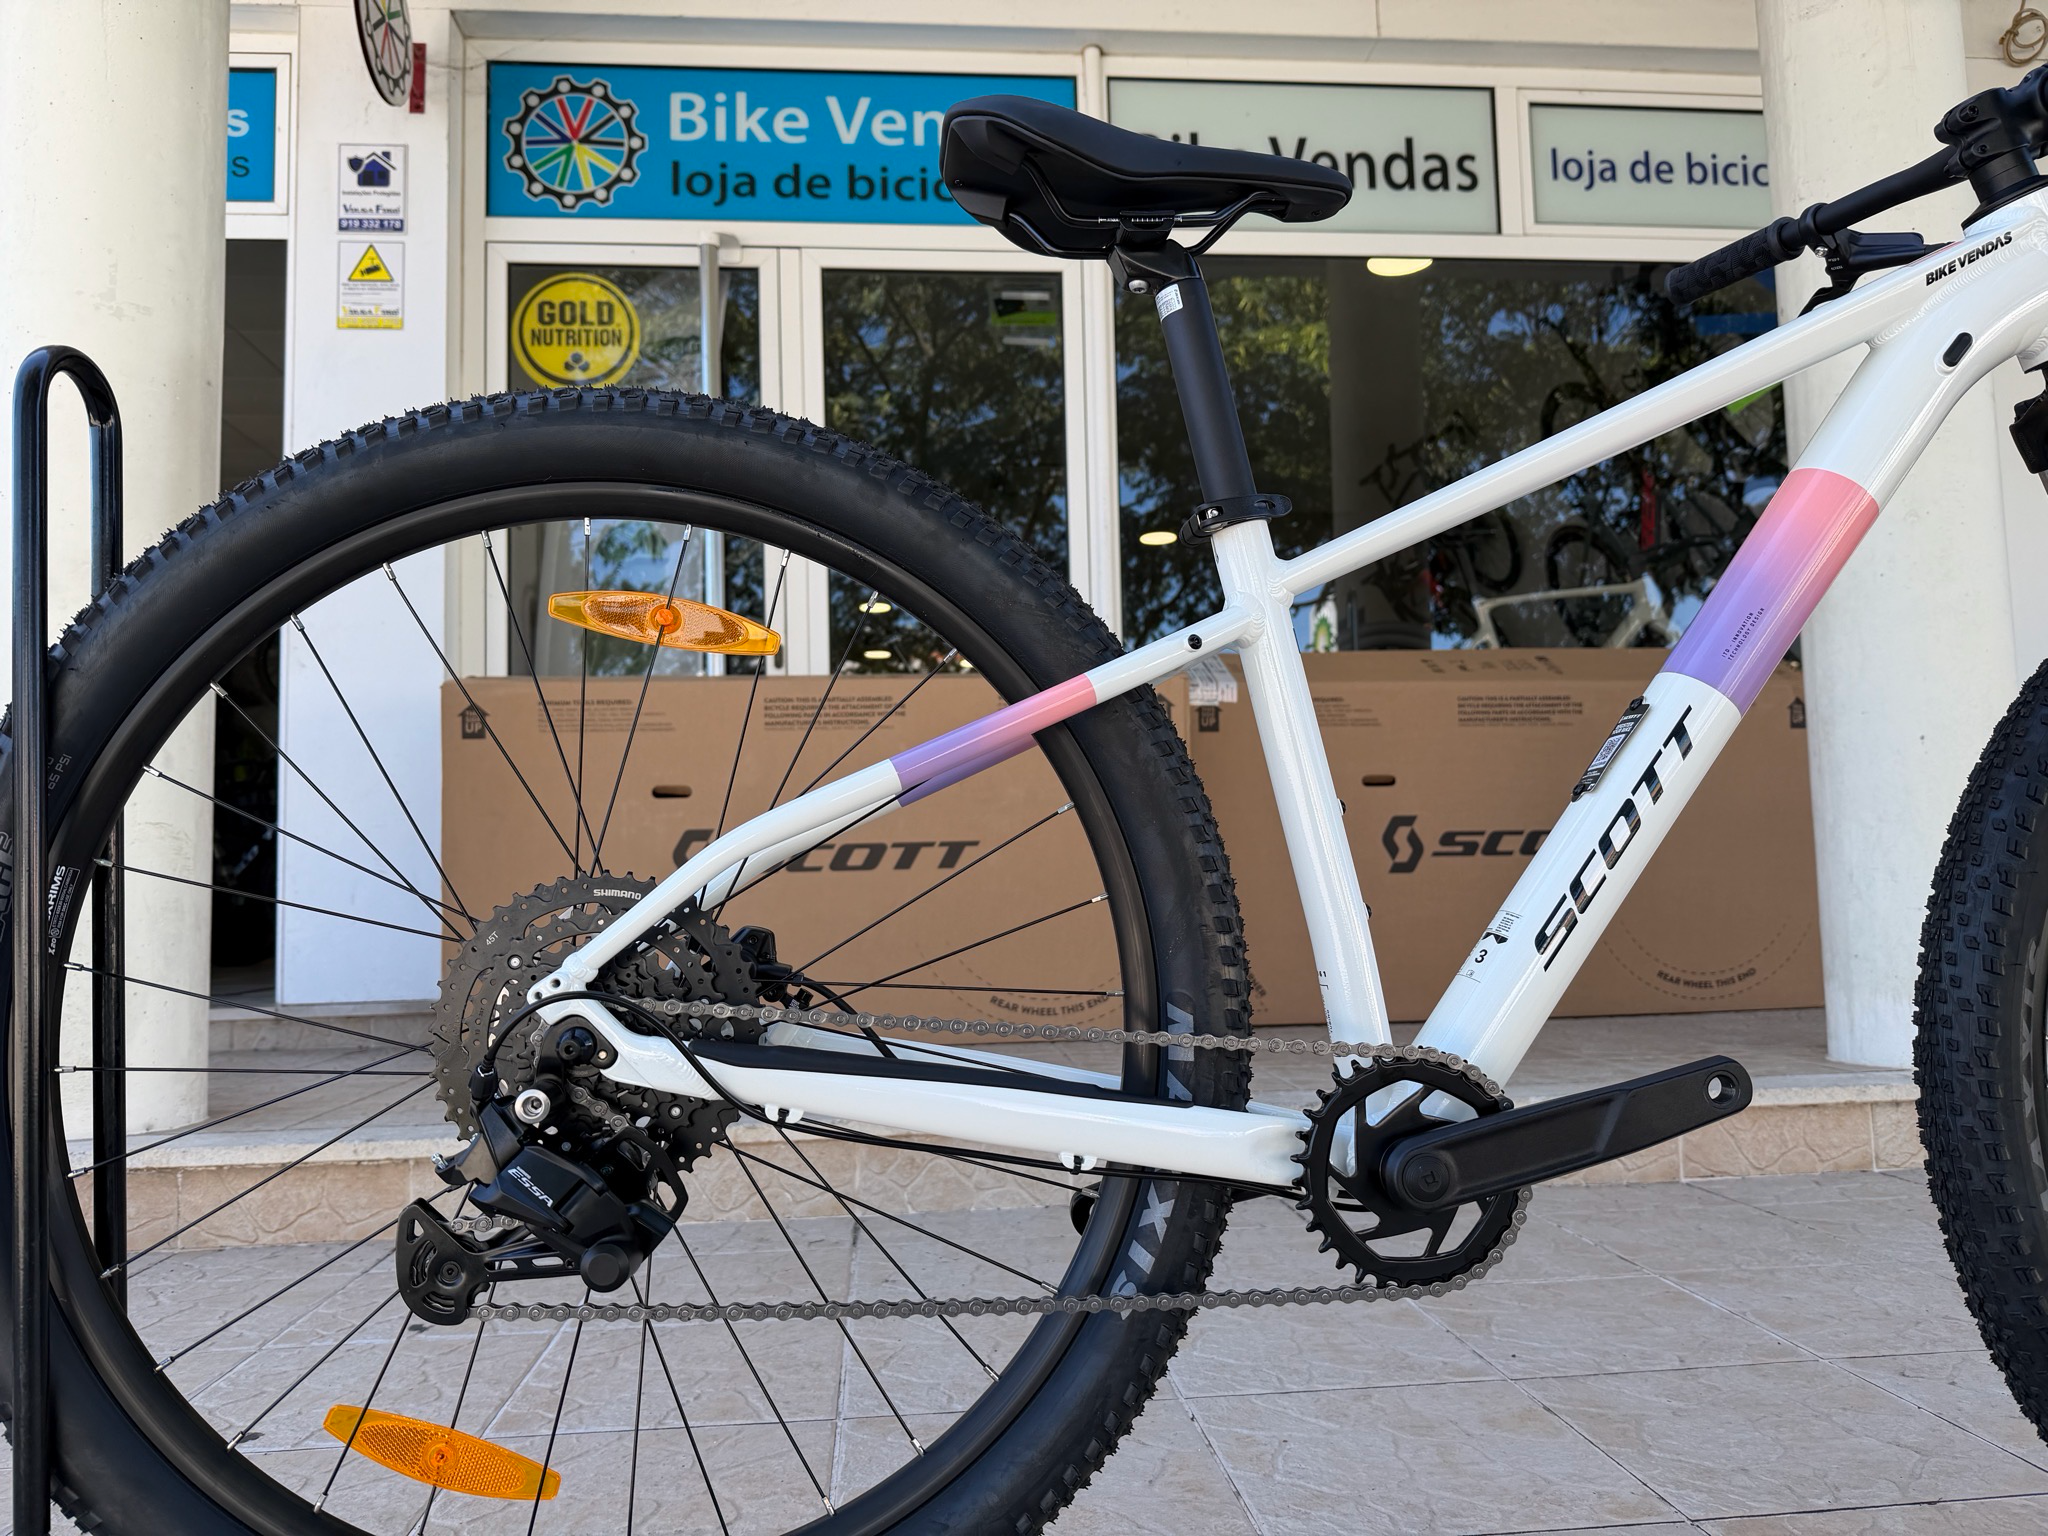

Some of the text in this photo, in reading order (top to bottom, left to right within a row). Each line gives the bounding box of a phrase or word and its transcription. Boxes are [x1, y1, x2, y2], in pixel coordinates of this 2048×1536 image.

[669, 91, 809, 144] Bike
[670, 161, 757, 206] loja
[773, 165, 832, 199] de
[1551, 148, 1769, 191] loja de bicic
[1925, 231, 2013, 286] BIKE VENDAS
[537, 301, 615, 326] GOLD
[530, 328, 622, 347] NUTRITION
[1728, 607, 1765, 661] TECHNOLOGY DESIGN
[466, 721, 483, 733] UP
[1535, 705, 1693, 972] SCOTT
[762, 840, 980, 873] COTT
[593, 888, 642, 900] SHIMANO
[486, 931, 499, 945] 45T
[1475, 949, 1488, 963] 3
[1657, 967, 1757, 989] REAR WHEEL THIS END
[990, 995, 1110, 1016] REAR WHEEL THIS END
[1110, 1001, 1195, 1319] MAXIS
[507, 1168, 553, 1208] ESSA
